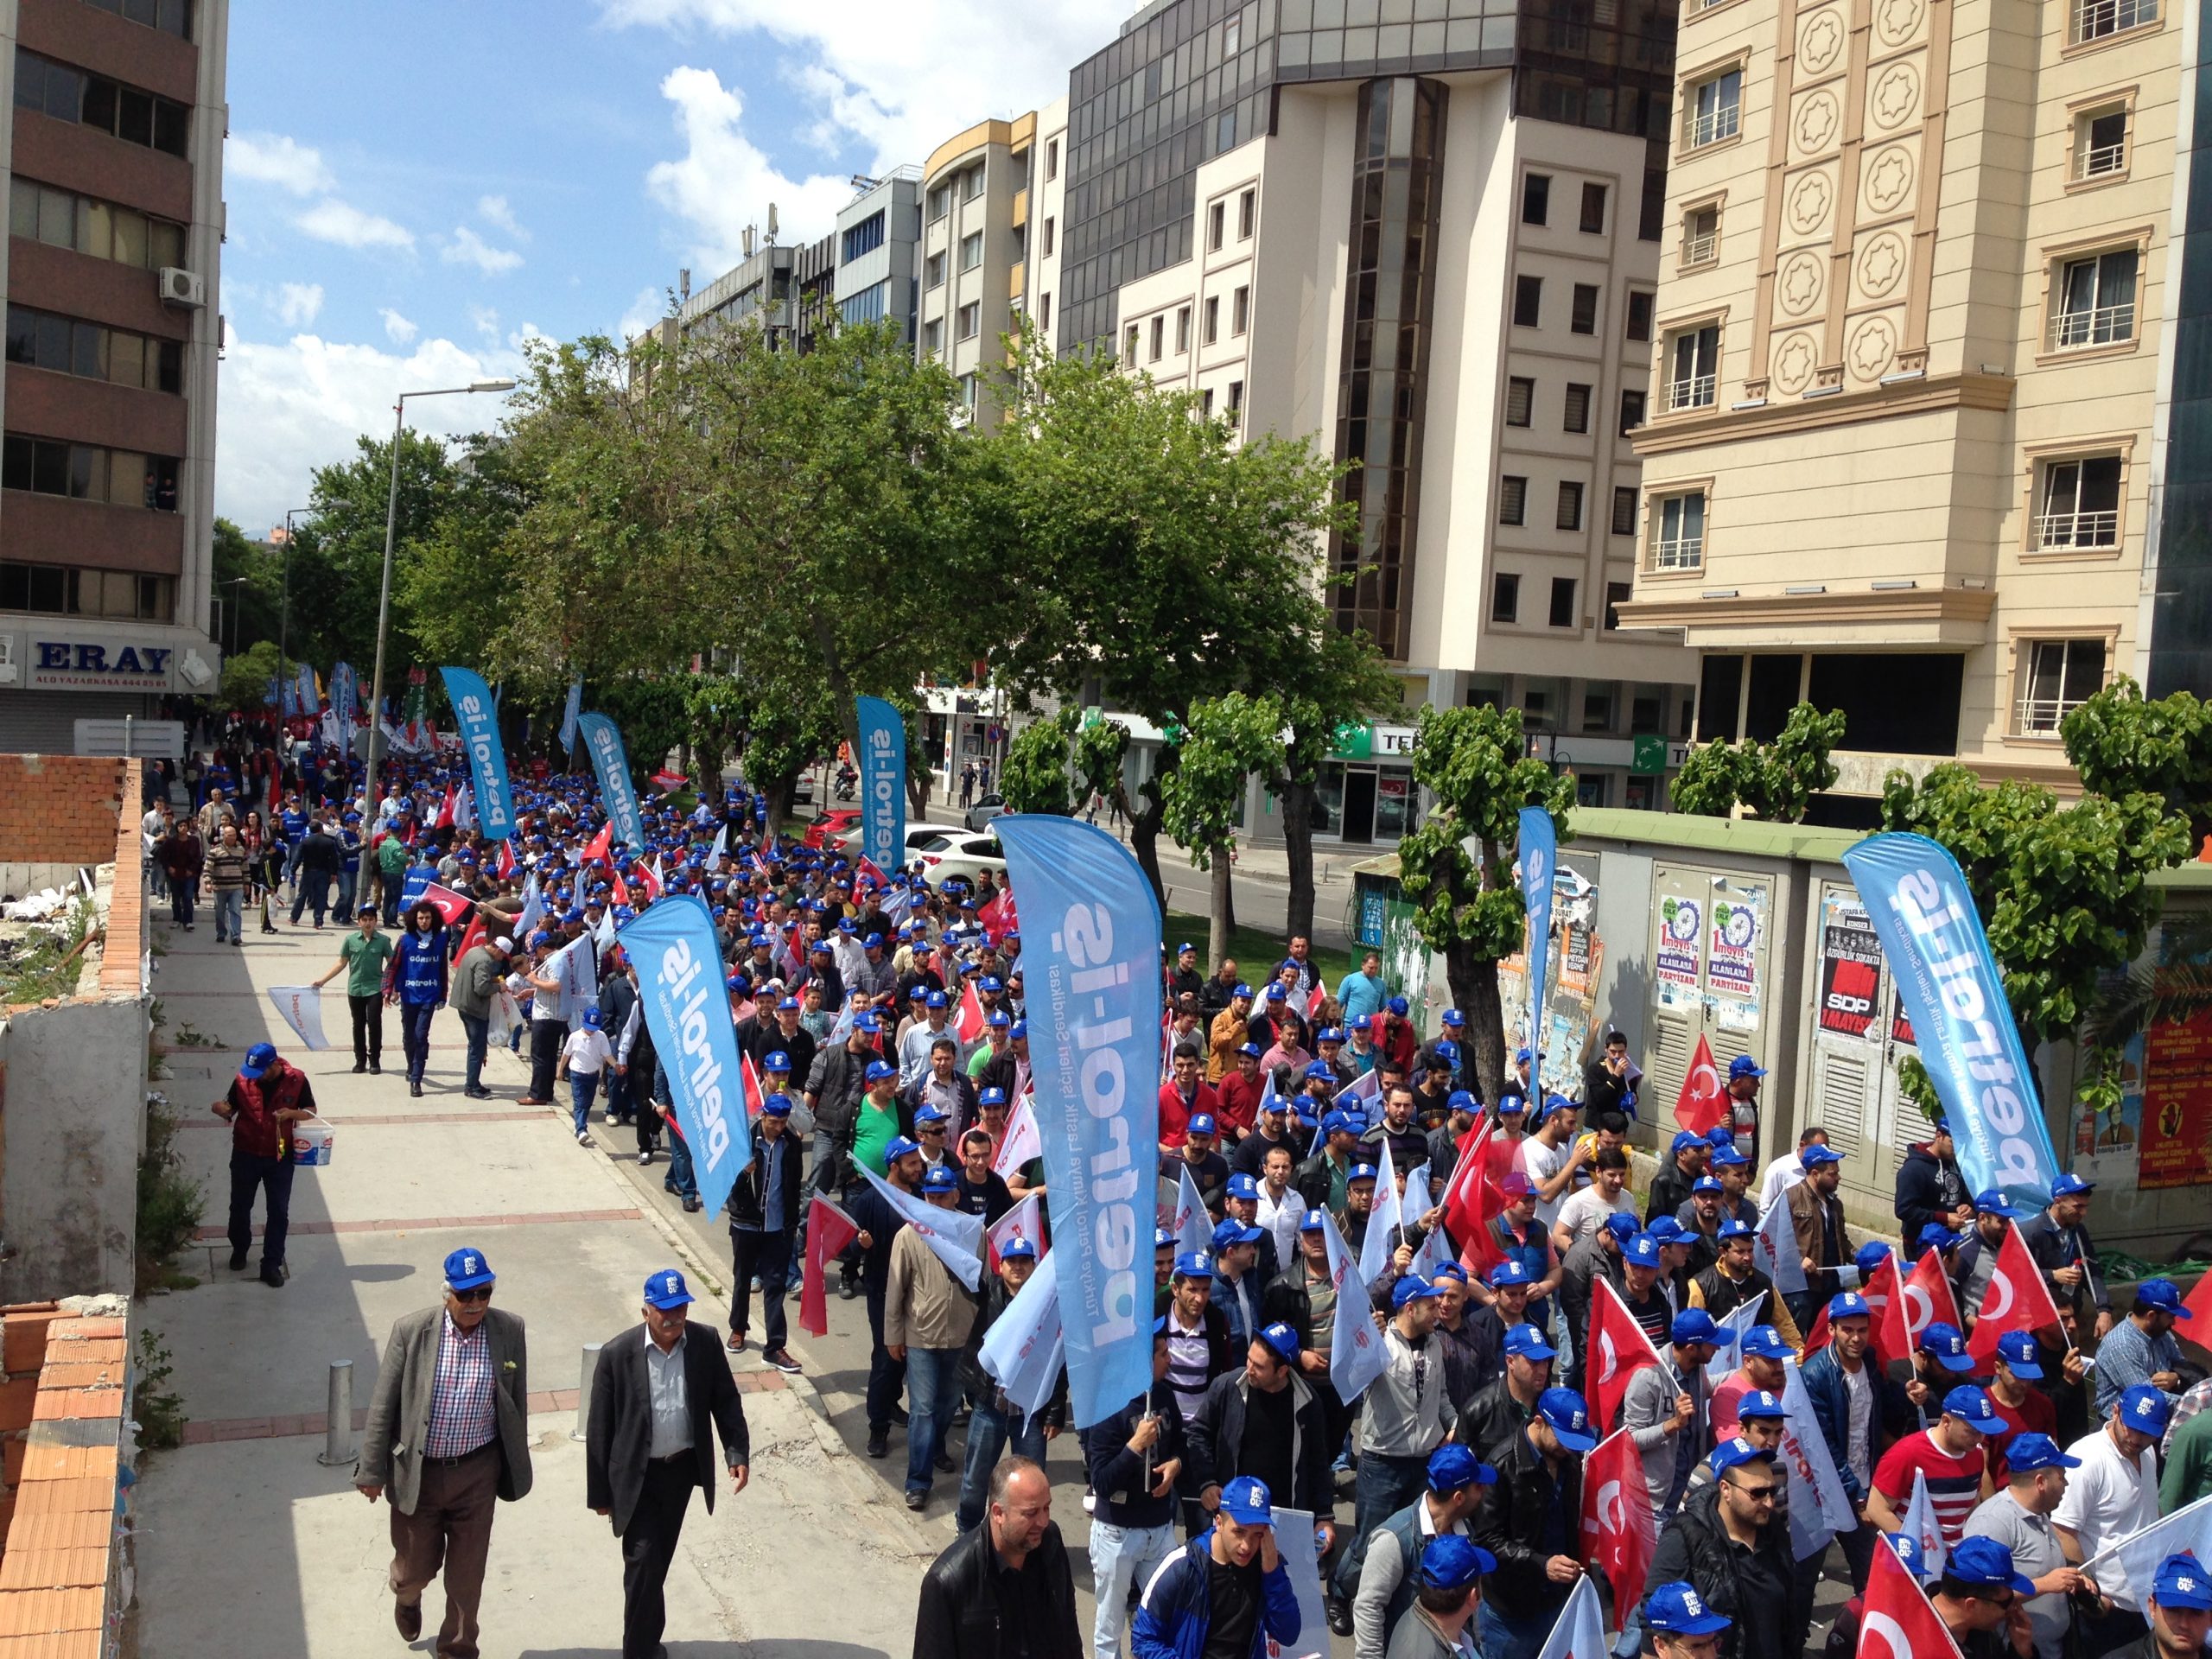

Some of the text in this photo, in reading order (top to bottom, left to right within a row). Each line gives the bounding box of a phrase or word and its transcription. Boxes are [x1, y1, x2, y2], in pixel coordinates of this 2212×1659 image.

[36, 642, 172, 674] ERAY
[1826, 947, 1880, 966] ÖZGÜRLÜK SOKAKTA
[1827, 993, 1871, 1014] SDP
